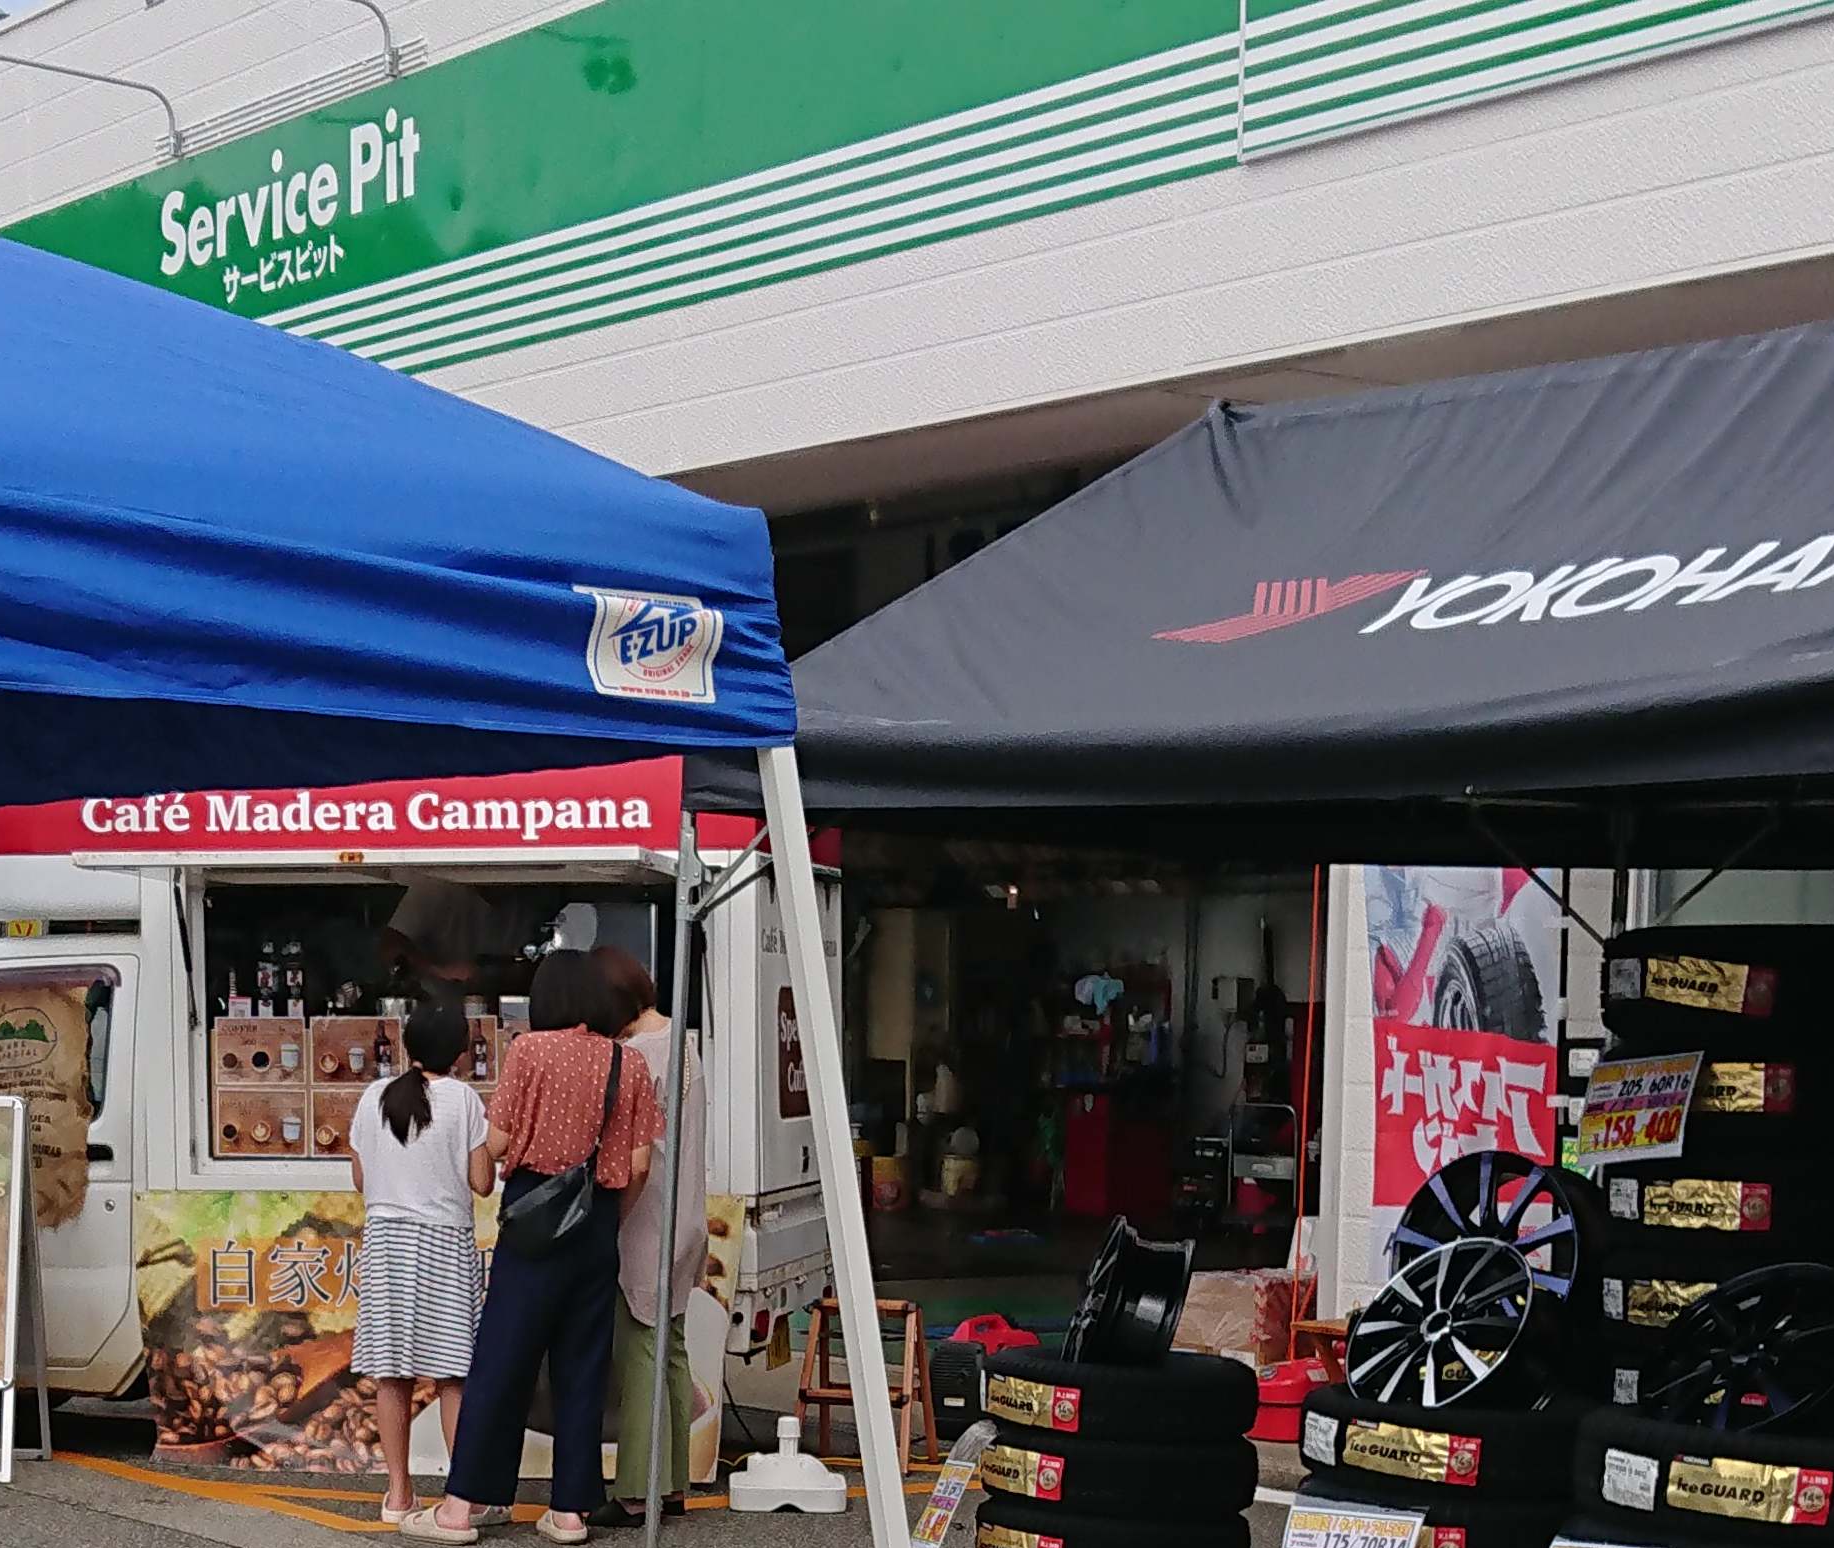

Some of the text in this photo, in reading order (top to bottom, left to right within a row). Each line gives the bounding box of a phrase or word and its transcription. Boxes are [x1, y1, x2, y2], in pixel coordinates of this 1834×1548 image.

[158, 106, 421, 277] Service Pit
[222, 233, 346, 305] サービスピット
[81, 792, 652, 840] Café Madera Campana
[1349, 1439, 1421, 1464] iceGUARD
[1676, 1476, 1765, 1504] iceGUARD
